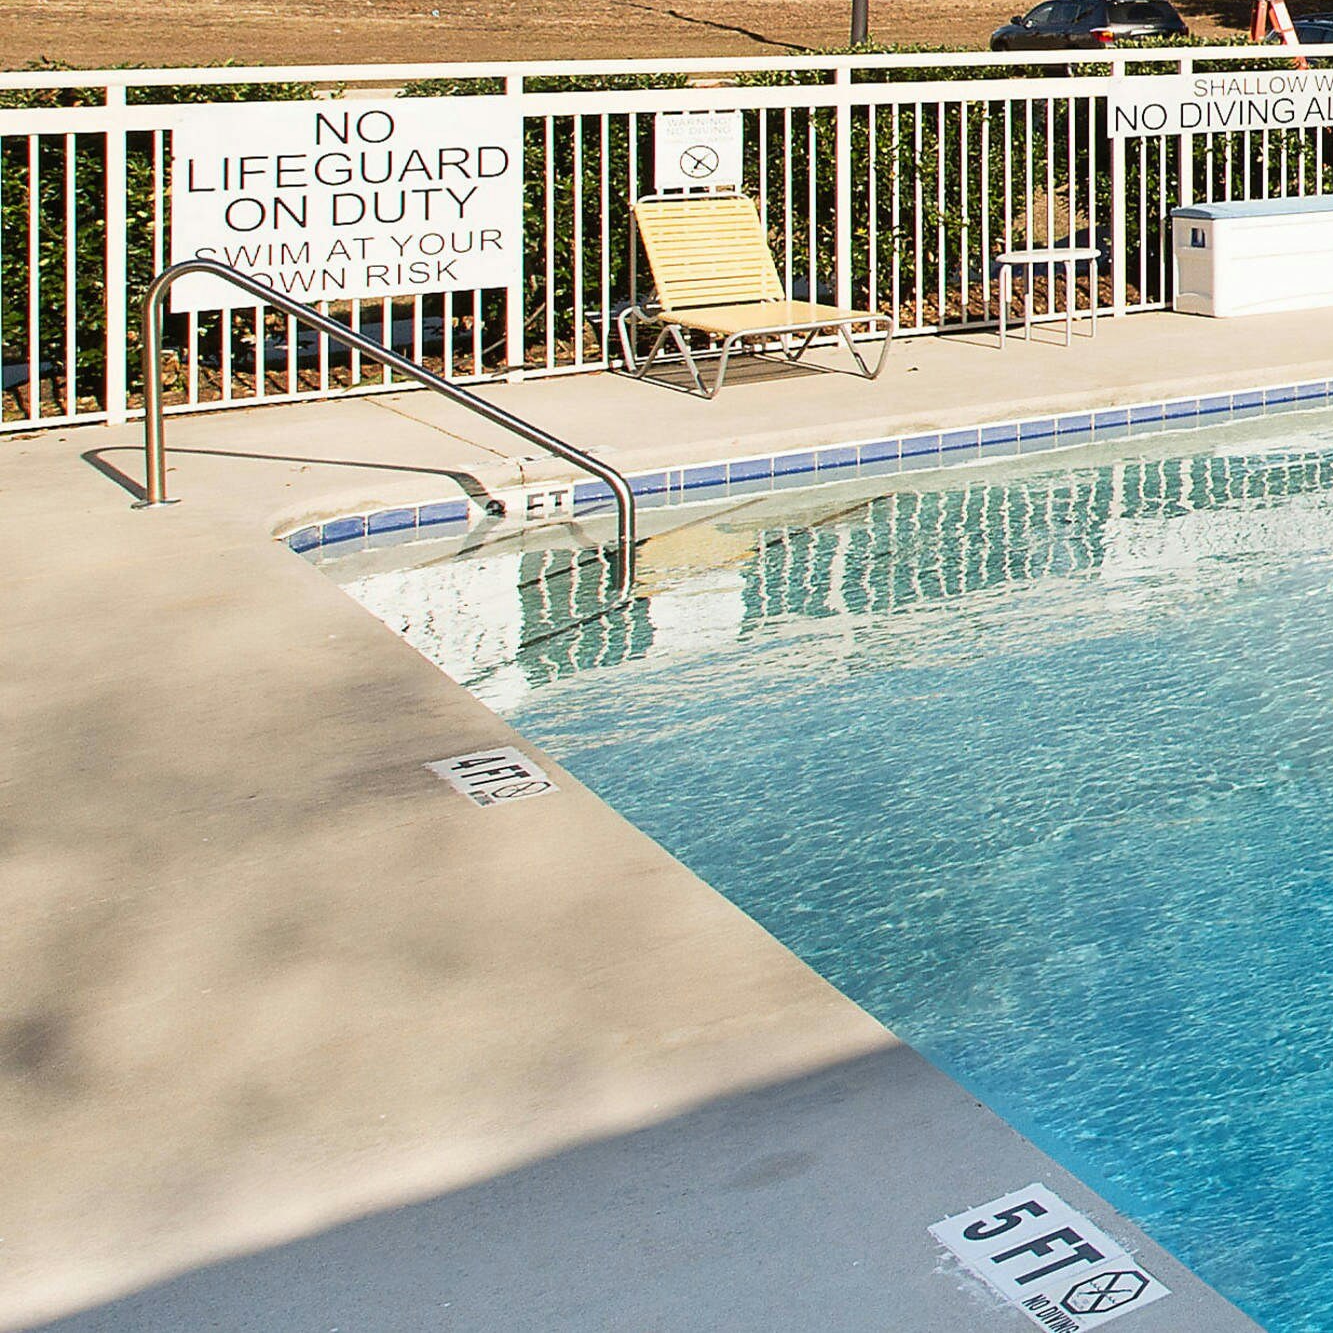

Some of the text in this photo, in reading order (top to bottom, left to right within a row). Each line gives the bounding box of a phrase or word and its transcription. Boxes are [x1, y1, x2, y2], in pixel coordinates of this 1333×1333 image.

[1193, 75, 1308, 98] SHALLOW
[315, 110, 395, 146] NO
[1115, 103, 1168, 132] NO
[1180, 97, 1295, 129] DIVING
[188, 146, 509, 193] LIFEGUARD
[225, 186, 478, 232] ON DUTY
[326, 237, 376, 262] AT
[390, 228, 504, 256] YOUR
[366, 258, 459, 288] RISK
[526, 489, 569, 511] FT
[450, 756, 531, 787] 4 FT
[962, 1200, 1106, 1286] 5 FT
[1022, 1294, 1051, 1311] NO
